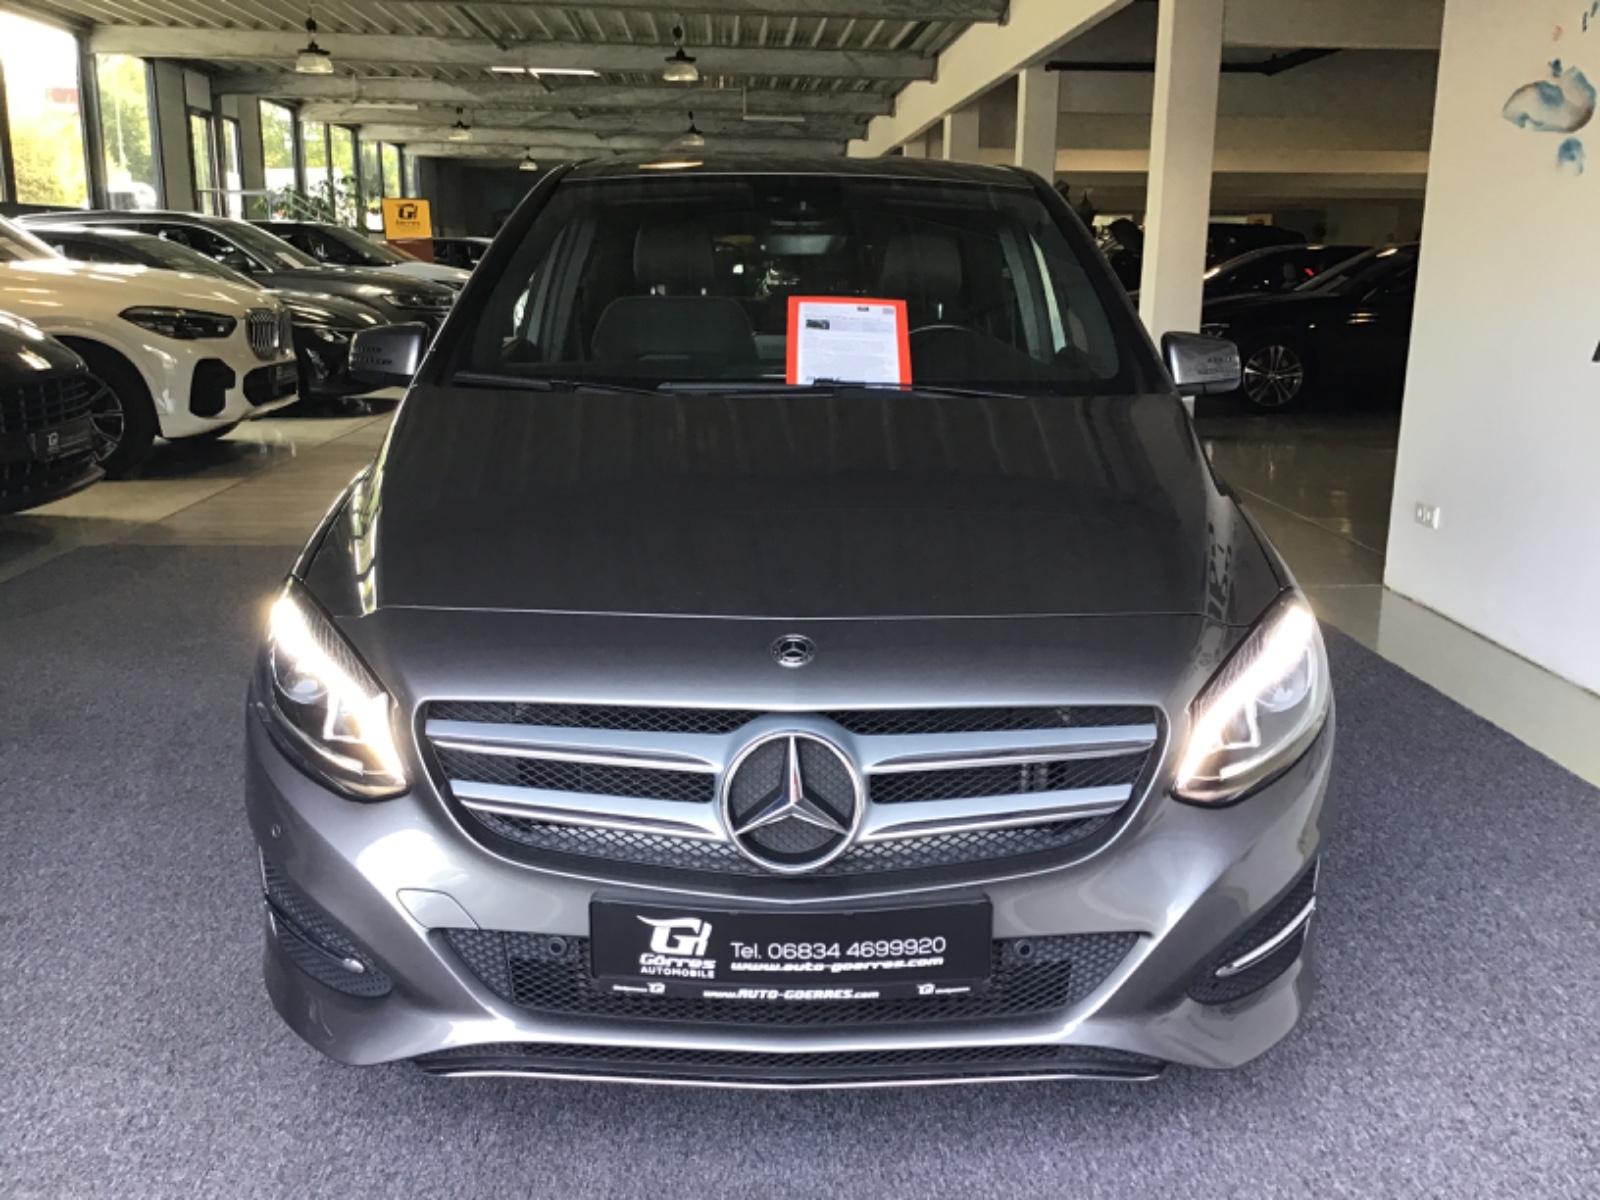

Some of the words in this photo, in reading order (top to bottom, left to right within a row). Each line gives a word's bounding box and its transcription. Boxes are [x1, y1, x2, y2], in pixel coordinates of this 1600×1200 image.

[730, 941, 762, 959] Tel.
[768, 941, 841, 960] 06834
[846, 936, 946, 958] 4699920
[640, 966, 715, 979] AUTOMOBILE
